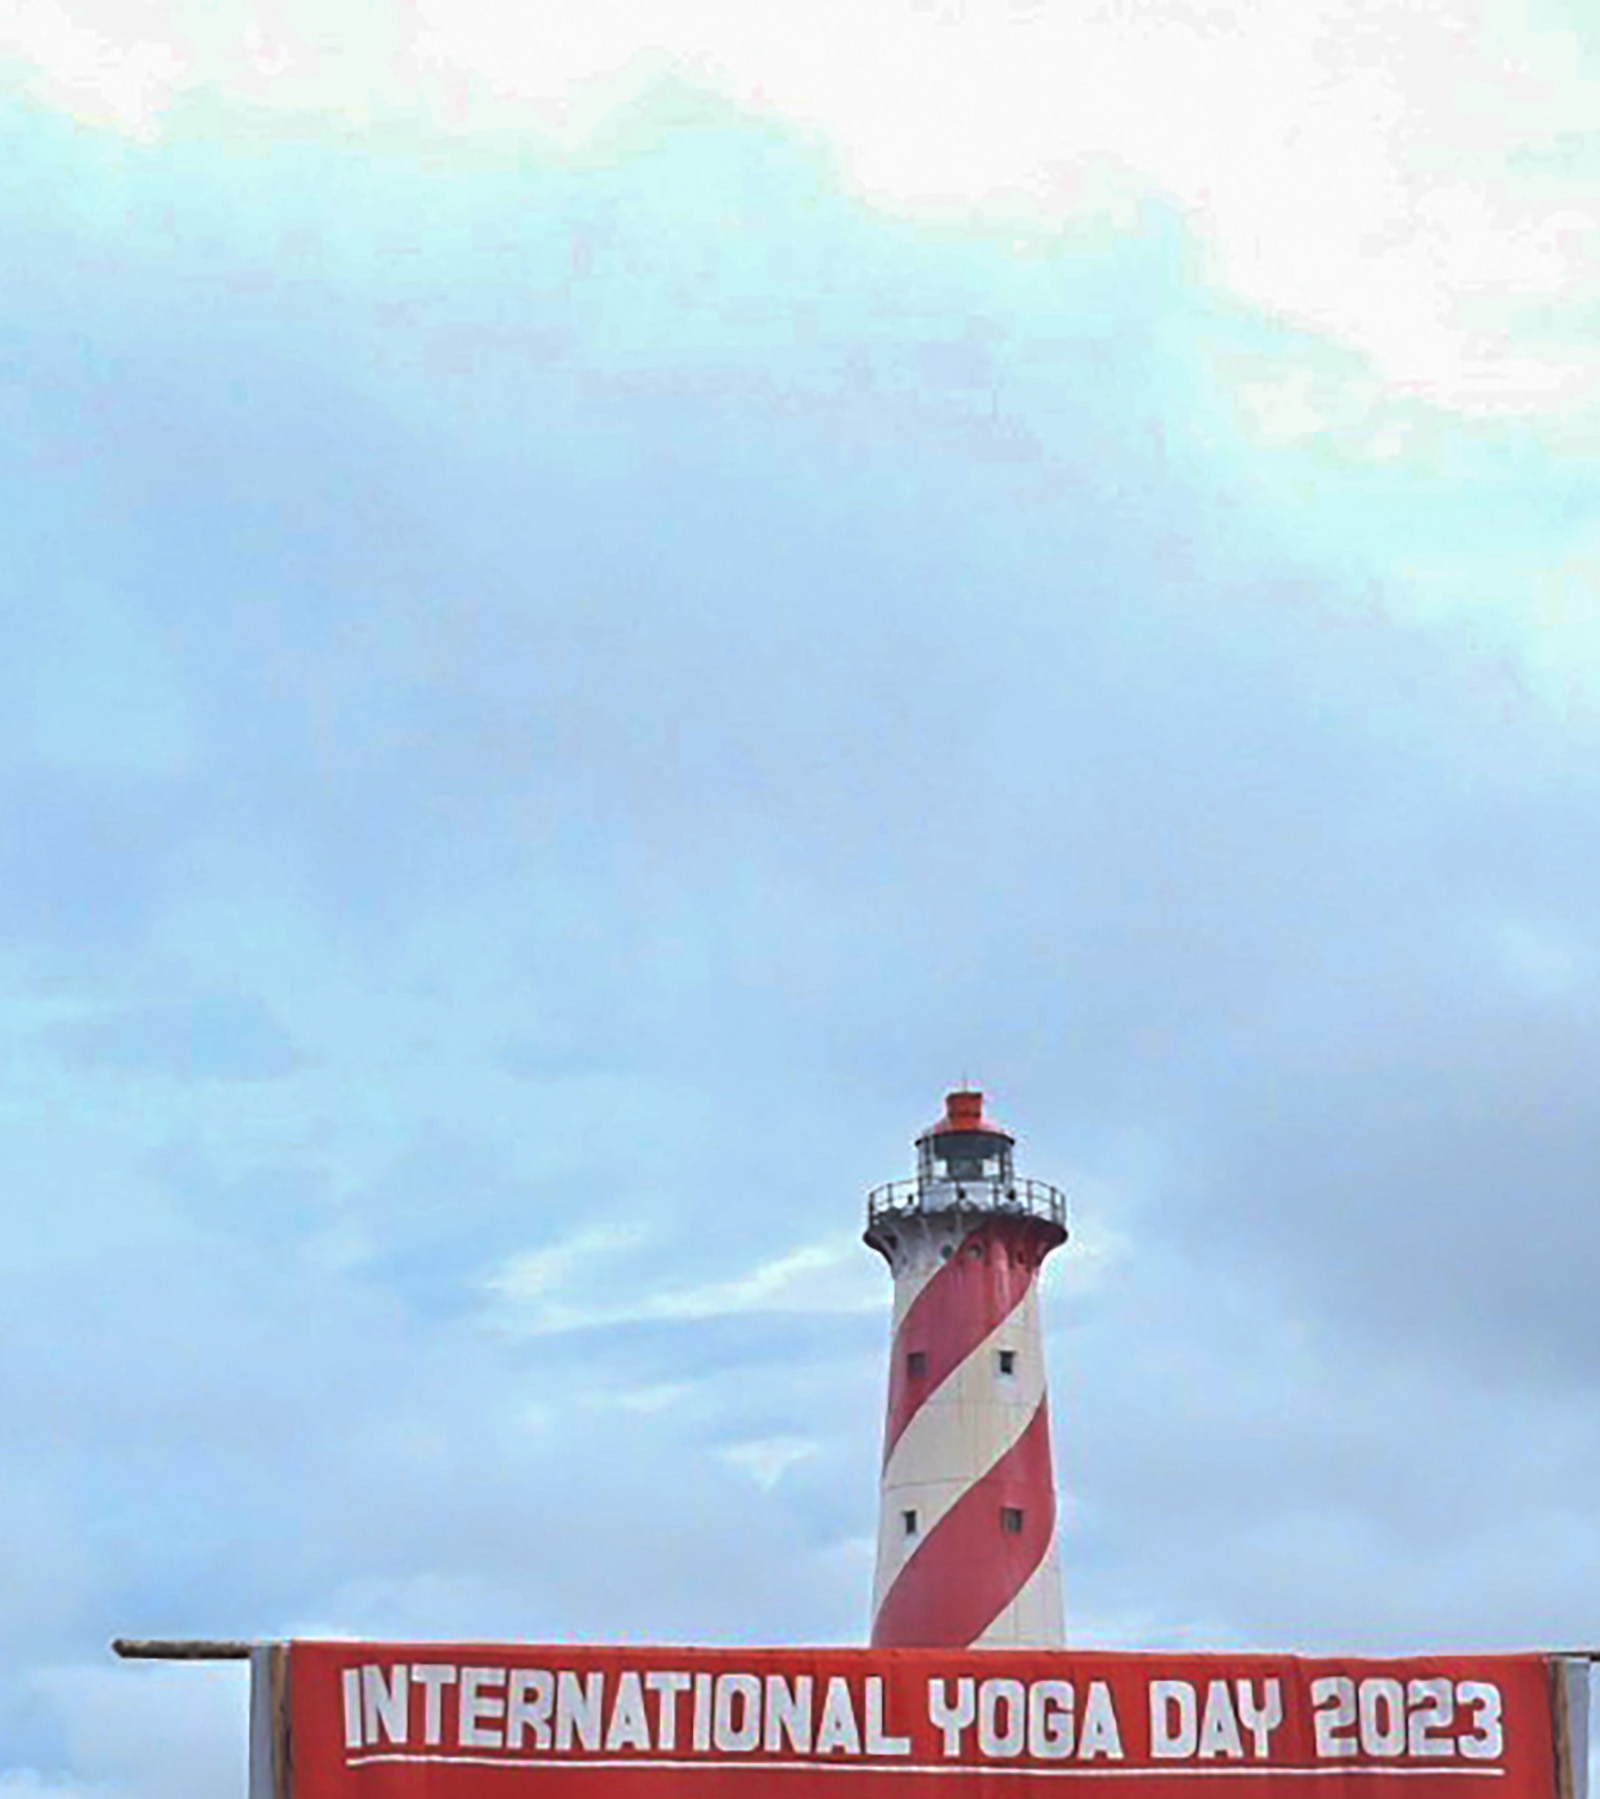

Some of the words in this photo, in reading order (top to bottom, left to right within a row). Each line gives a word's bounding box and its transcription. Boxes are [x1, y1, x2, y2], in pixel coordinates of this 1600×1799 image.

[342, 1663, 912, 1756] INTERNATIONAL
[927, 1677, 1125, 1761] YOGA
[1149, 1677, 1283, 1761] DAY
[1310, 1676, 1504, 1761] 2023
